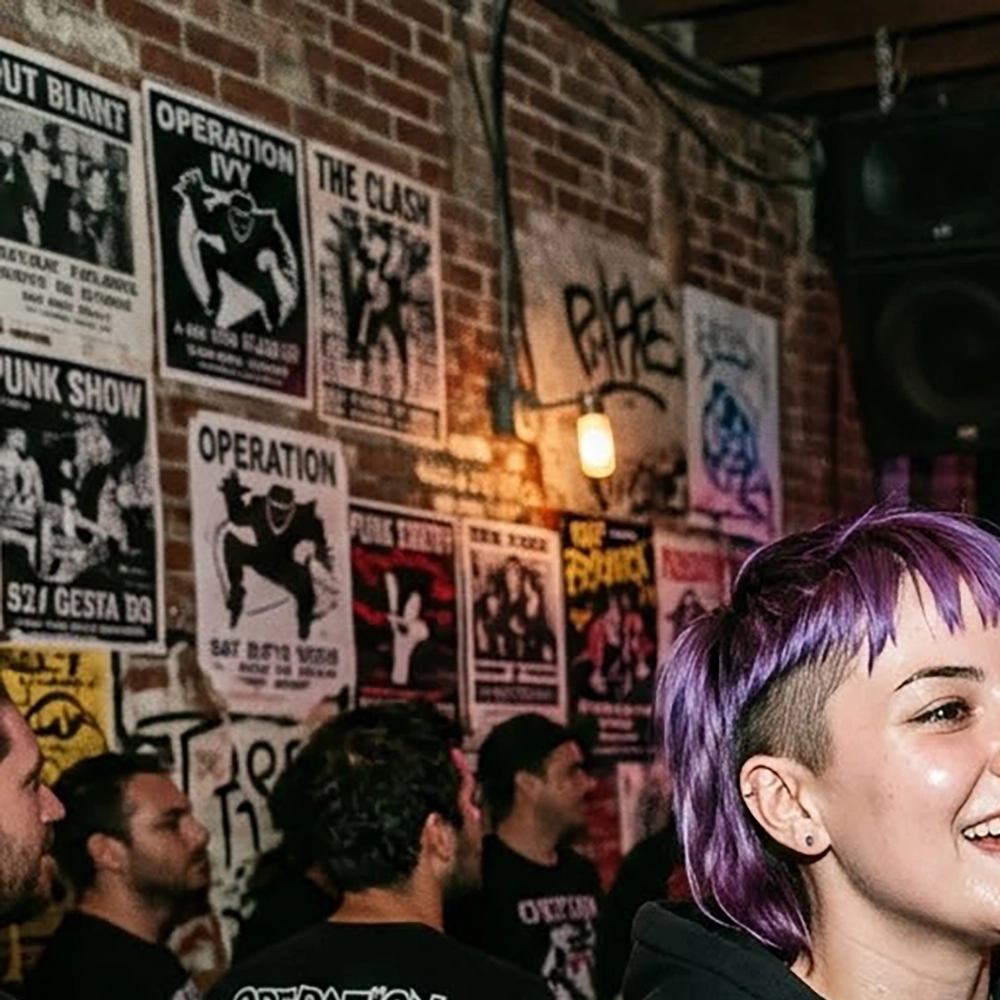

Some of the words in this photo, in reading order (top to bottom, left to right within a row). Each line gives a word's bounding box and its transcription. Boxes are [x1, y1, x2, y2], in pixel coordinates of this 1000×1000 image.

[0, 57, 38, 101] UT
[156, 100, 296, 176] OPERATION
[210, 151, 252, 190] IVY
[315, 152, 359, 201] THE
[364, 170, 432, 228] CLASH
[0, 355, 62, 403] UNK
[66, 369, 142, 419] SHOW
[199, 426, 337, 488] OPERATION
